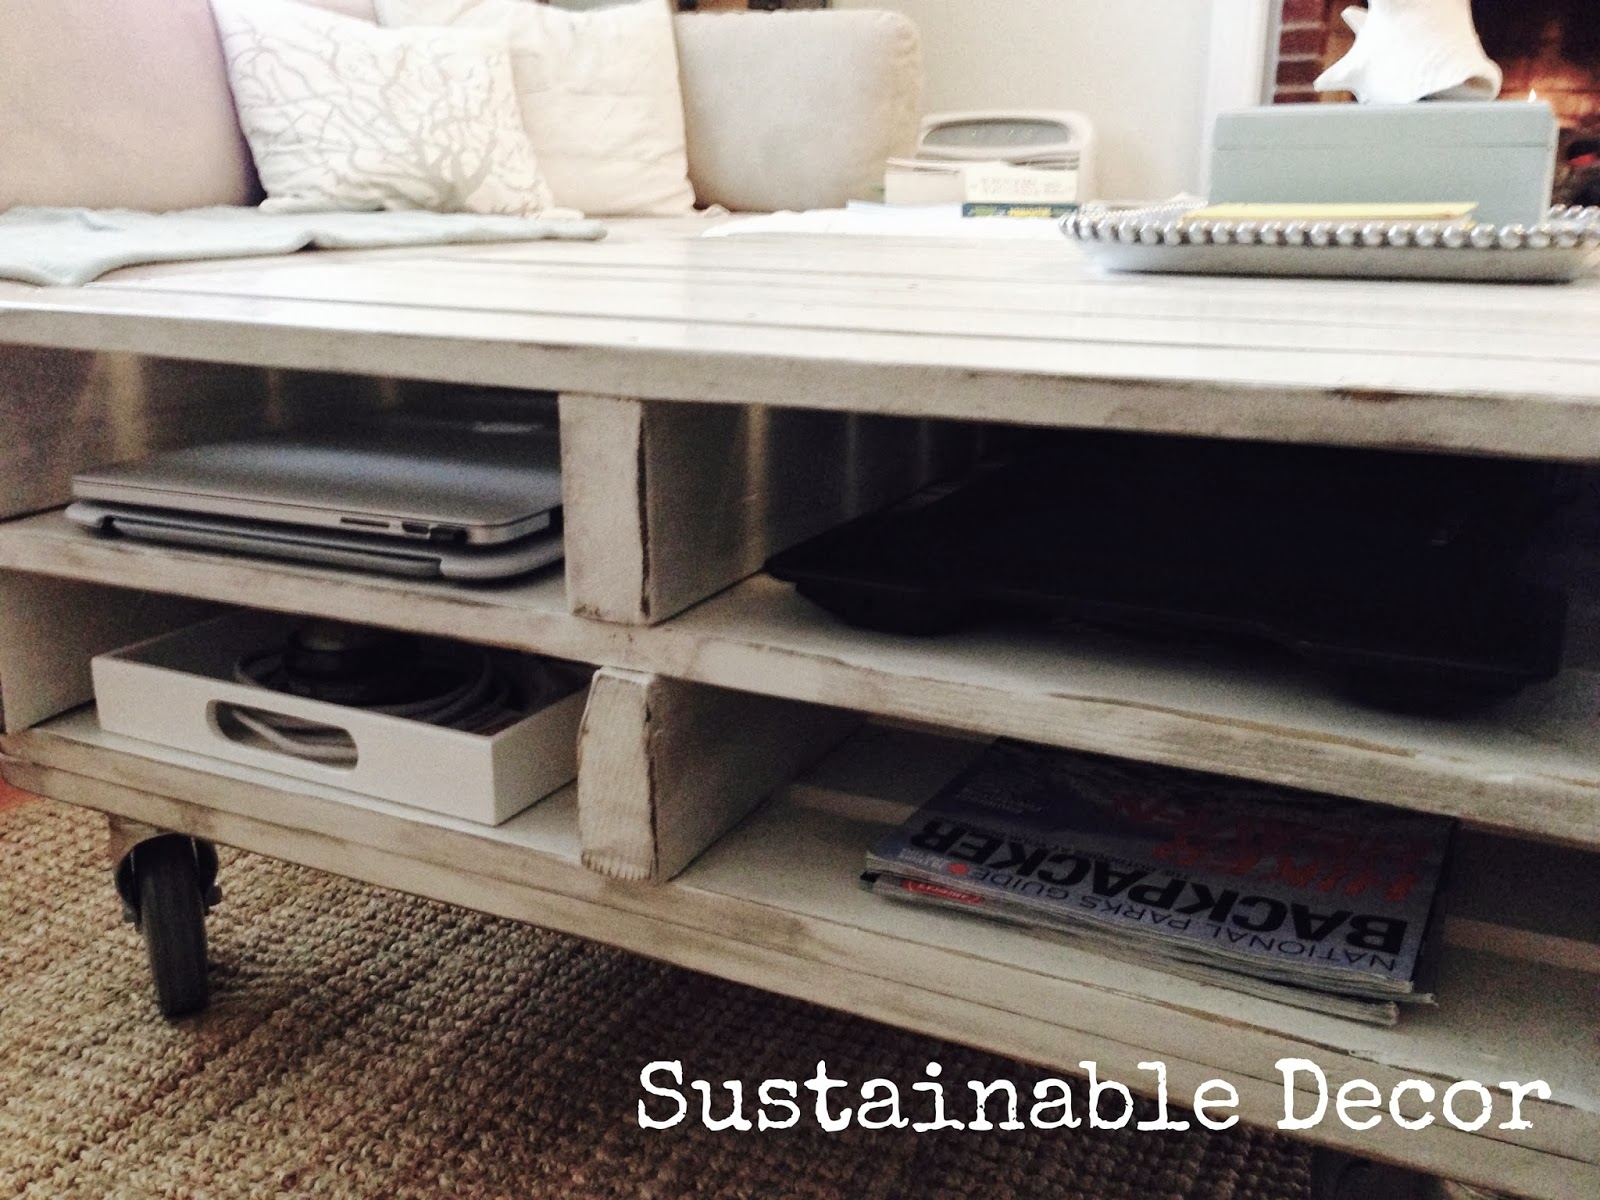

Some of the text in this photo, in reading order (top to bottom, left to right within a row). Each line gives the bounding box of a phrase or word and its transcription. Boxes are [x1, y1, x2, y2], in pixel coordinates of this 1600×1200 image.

[909, 819, 1408, 956] BACKPACKER
[972, 867, 1069, 900] GUIDE
[1077, 896, 1192, 931] PARKS
[1204, 923, 1396, 971] NATIONAL
